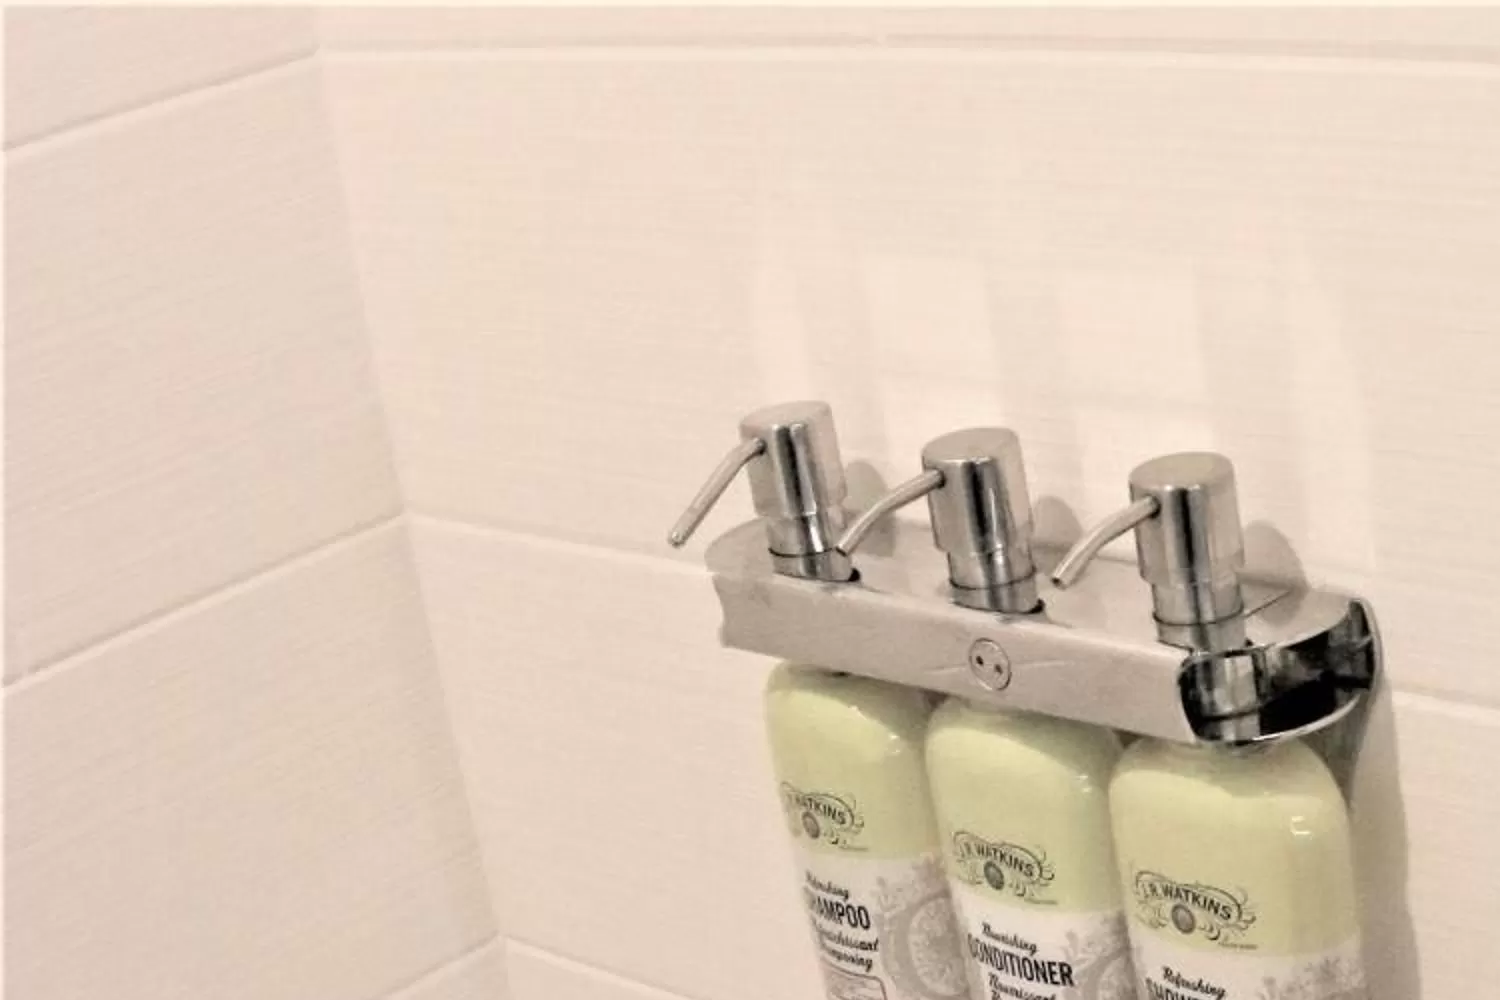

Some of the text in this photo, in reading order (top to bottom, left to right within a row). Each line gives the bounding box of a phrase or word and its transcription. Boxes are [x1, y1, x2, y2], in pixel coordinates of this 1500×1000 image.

[974, 843, 1034, 877] WATKINS
[1162, 884, 1231, 921] WATKINS
[967, 933, 1075, 987] CONDITIONER
